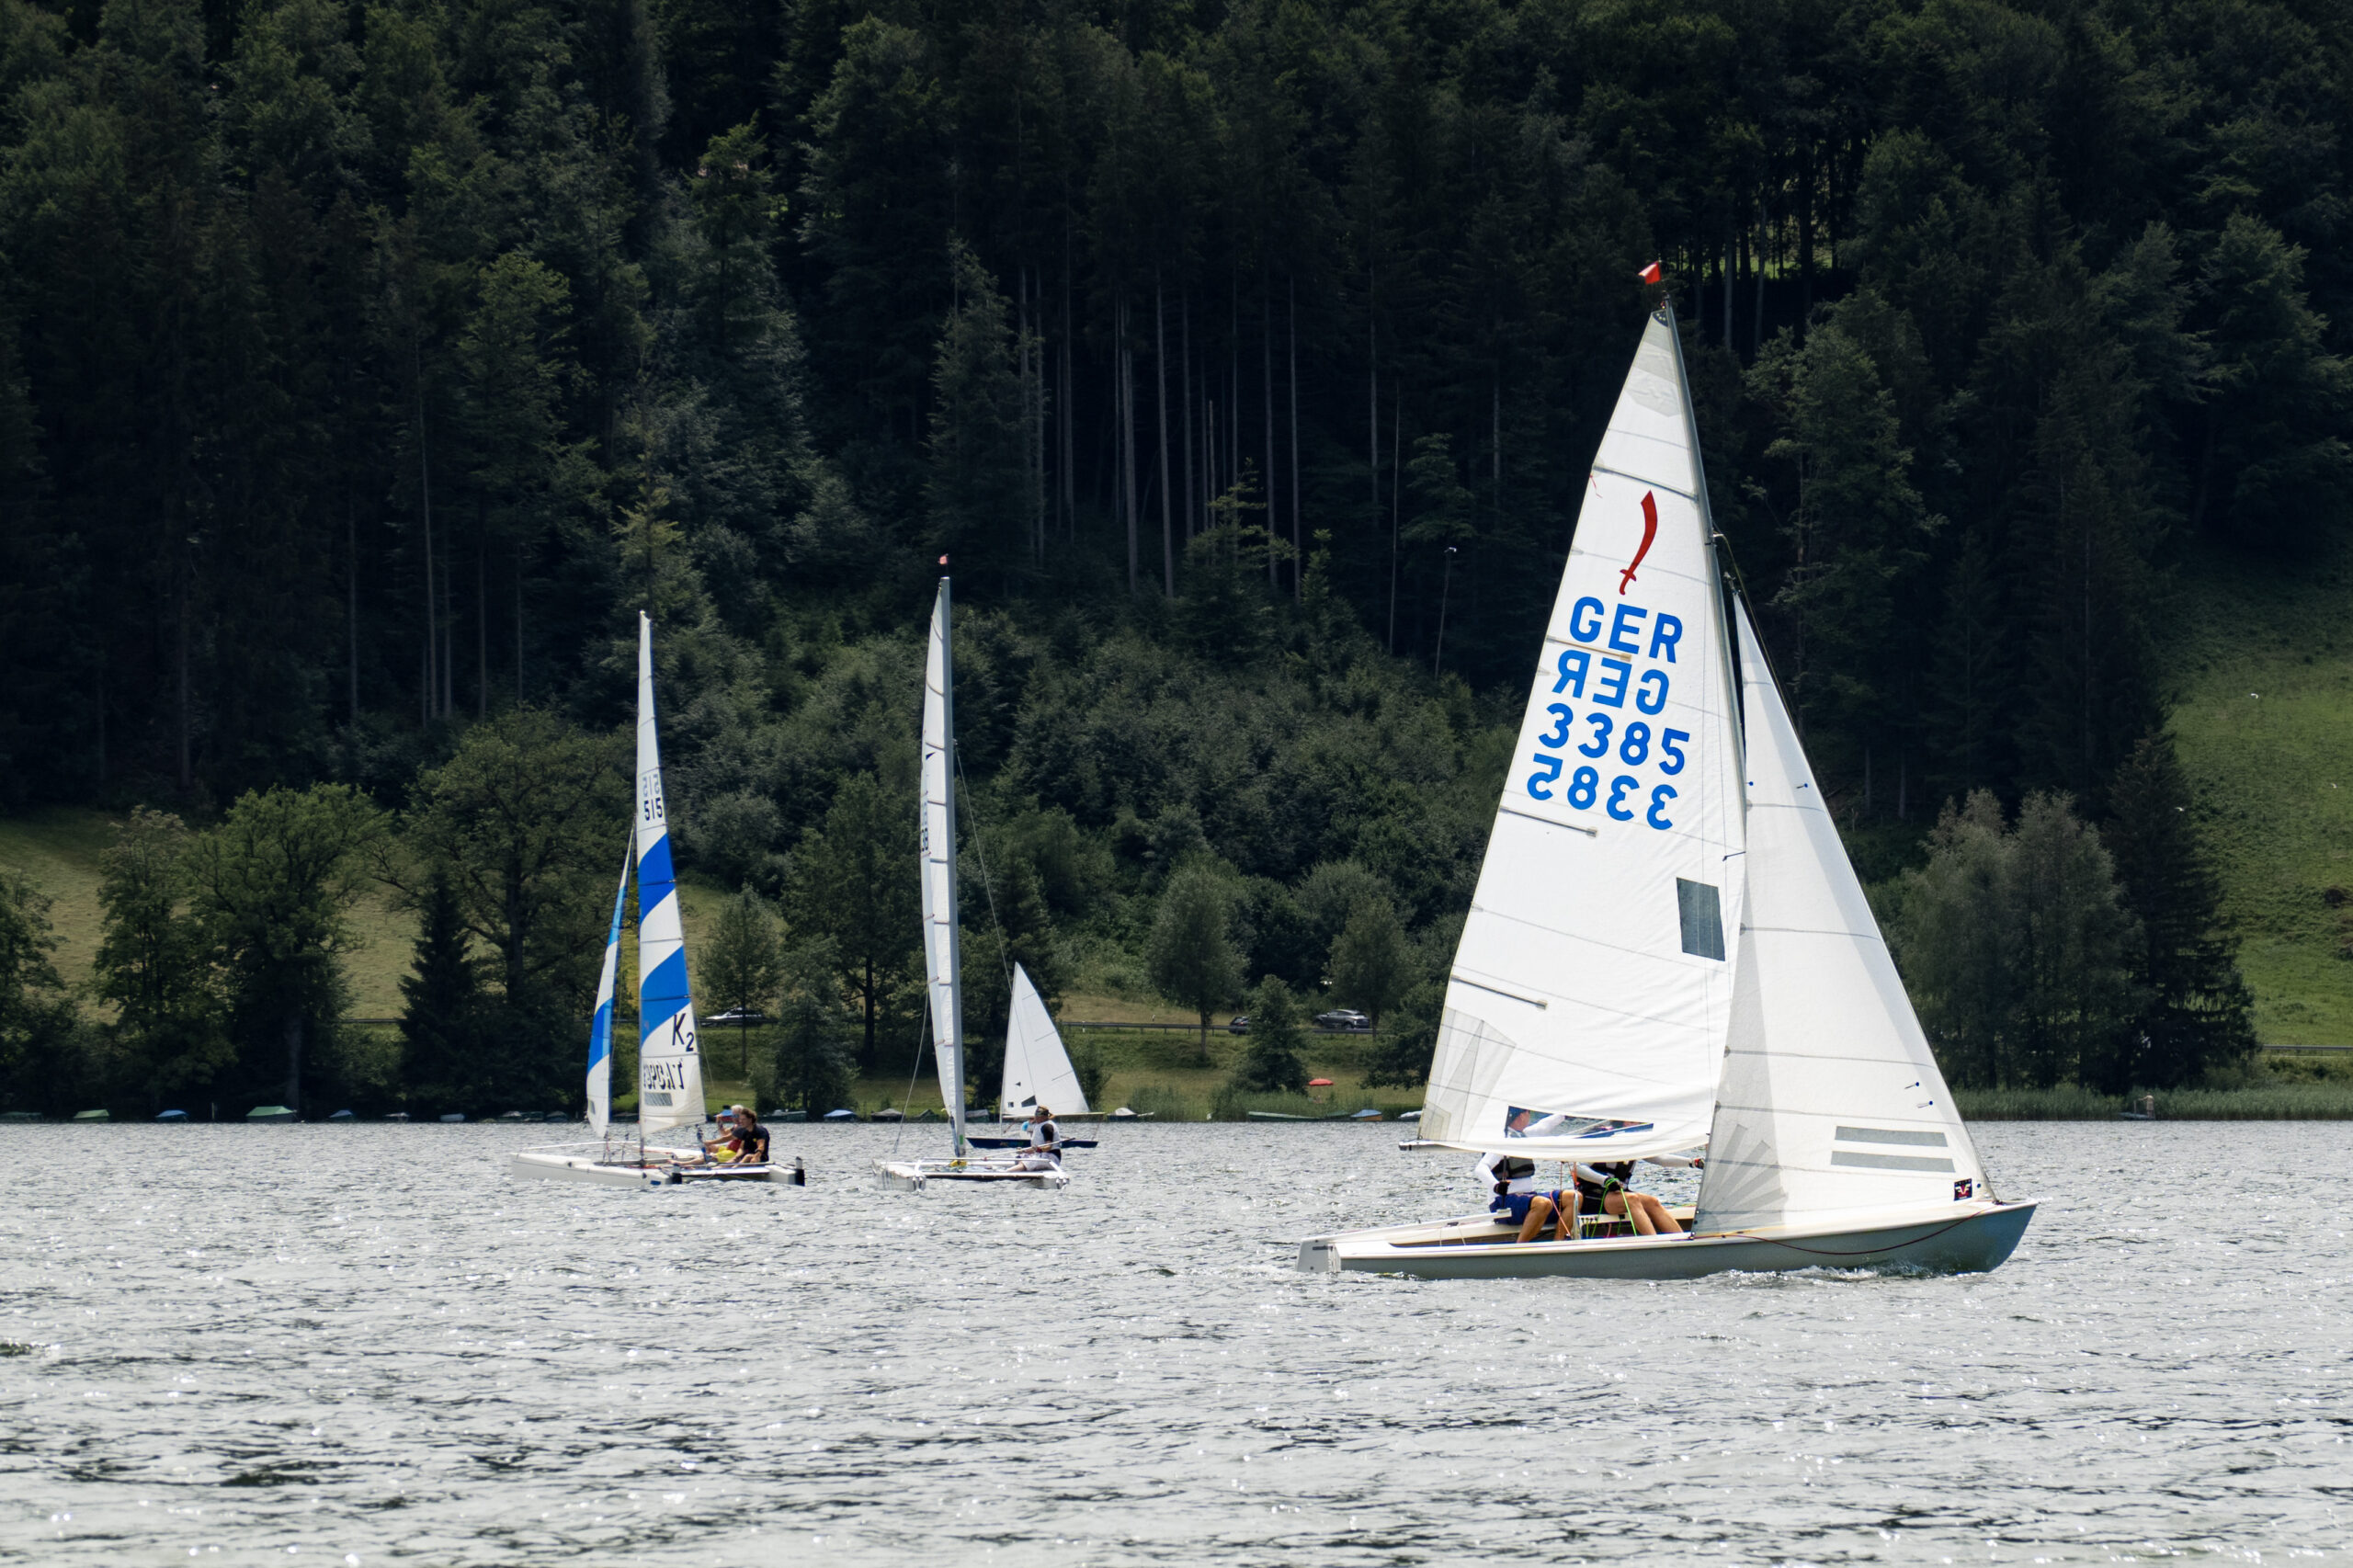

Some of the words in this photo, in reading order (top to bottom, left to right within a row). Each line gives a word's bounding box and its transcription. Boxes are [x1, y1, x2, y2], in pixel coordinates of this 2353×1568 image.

[1570, 597, 1683, 664] GER
[1539, 703, 1690, 776] 3385
[643, 797, 663, 821] 515
